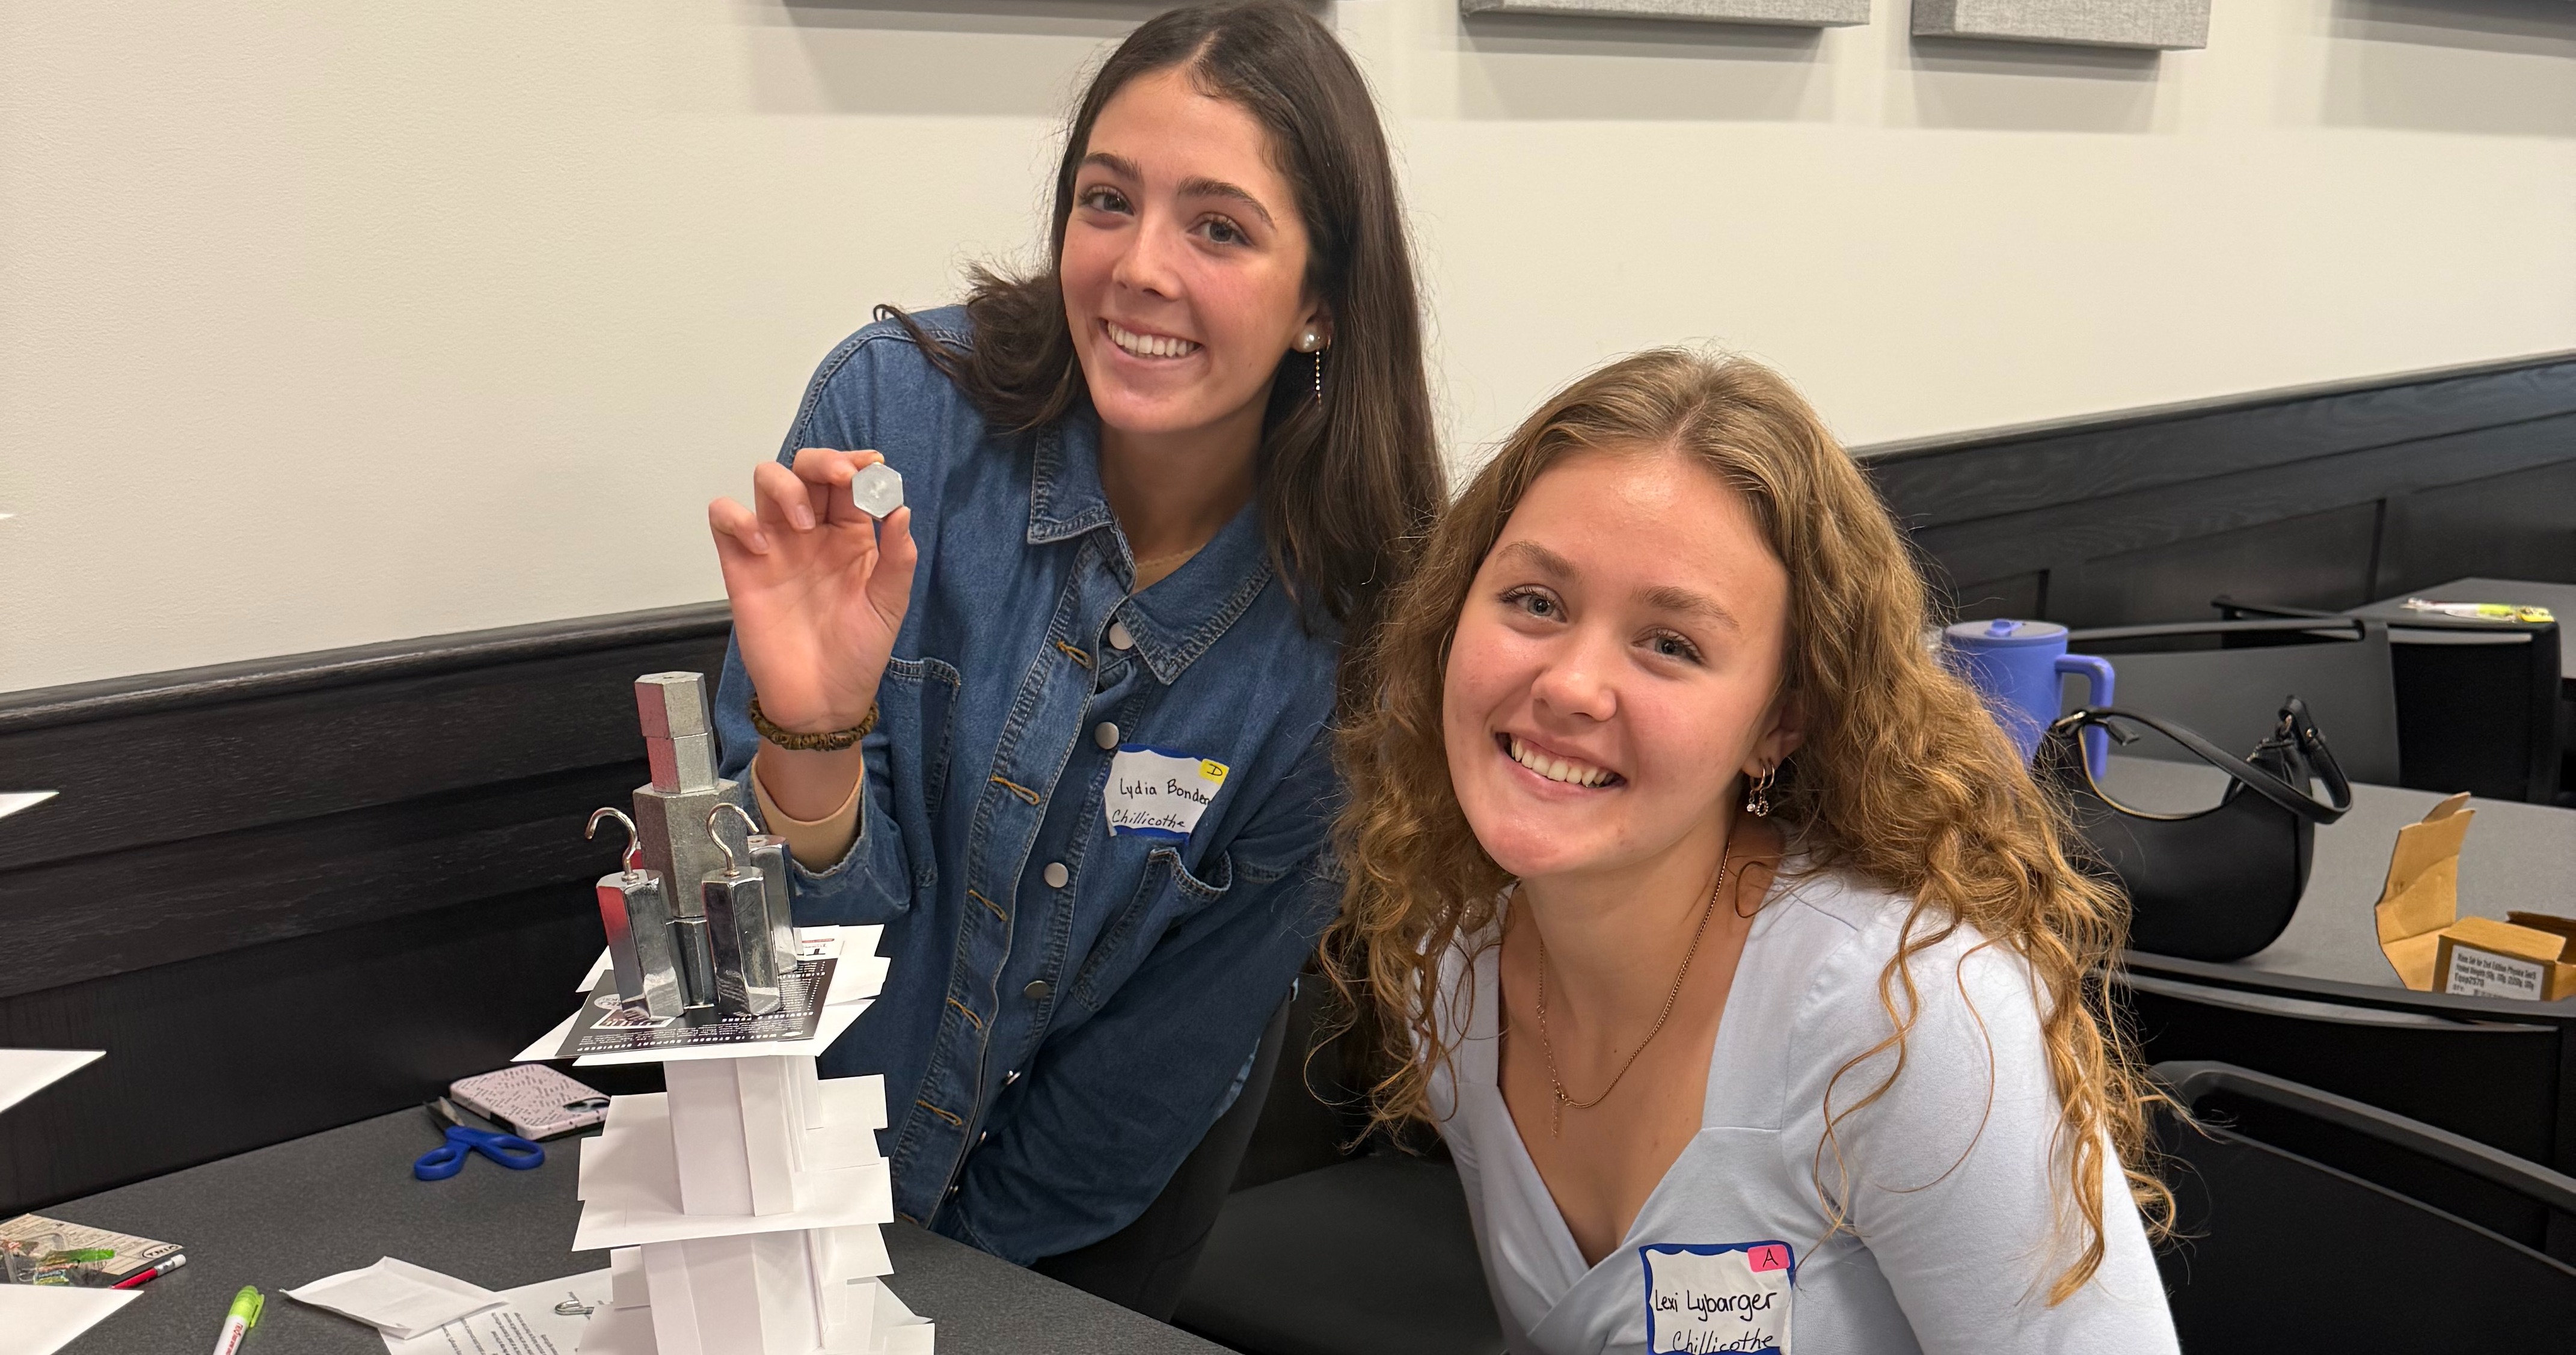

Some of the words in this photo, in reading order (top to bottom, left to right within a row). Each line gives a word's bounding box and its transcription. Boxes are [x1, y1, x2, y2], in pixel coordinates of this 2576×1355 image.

[1207, 763, 1223, 777] D
[1120, 778, 1157, 800] Lydia
[1112, 809, 1186, 828] Chillicothe
[1762, 1248, 1779, 1268] A
[1655, 1289, 1678, 1312] Lexi
[1687, 1289, 1777, 1322] Lybarger
[1673, 1328, 1773, 1354] Chillicothe
